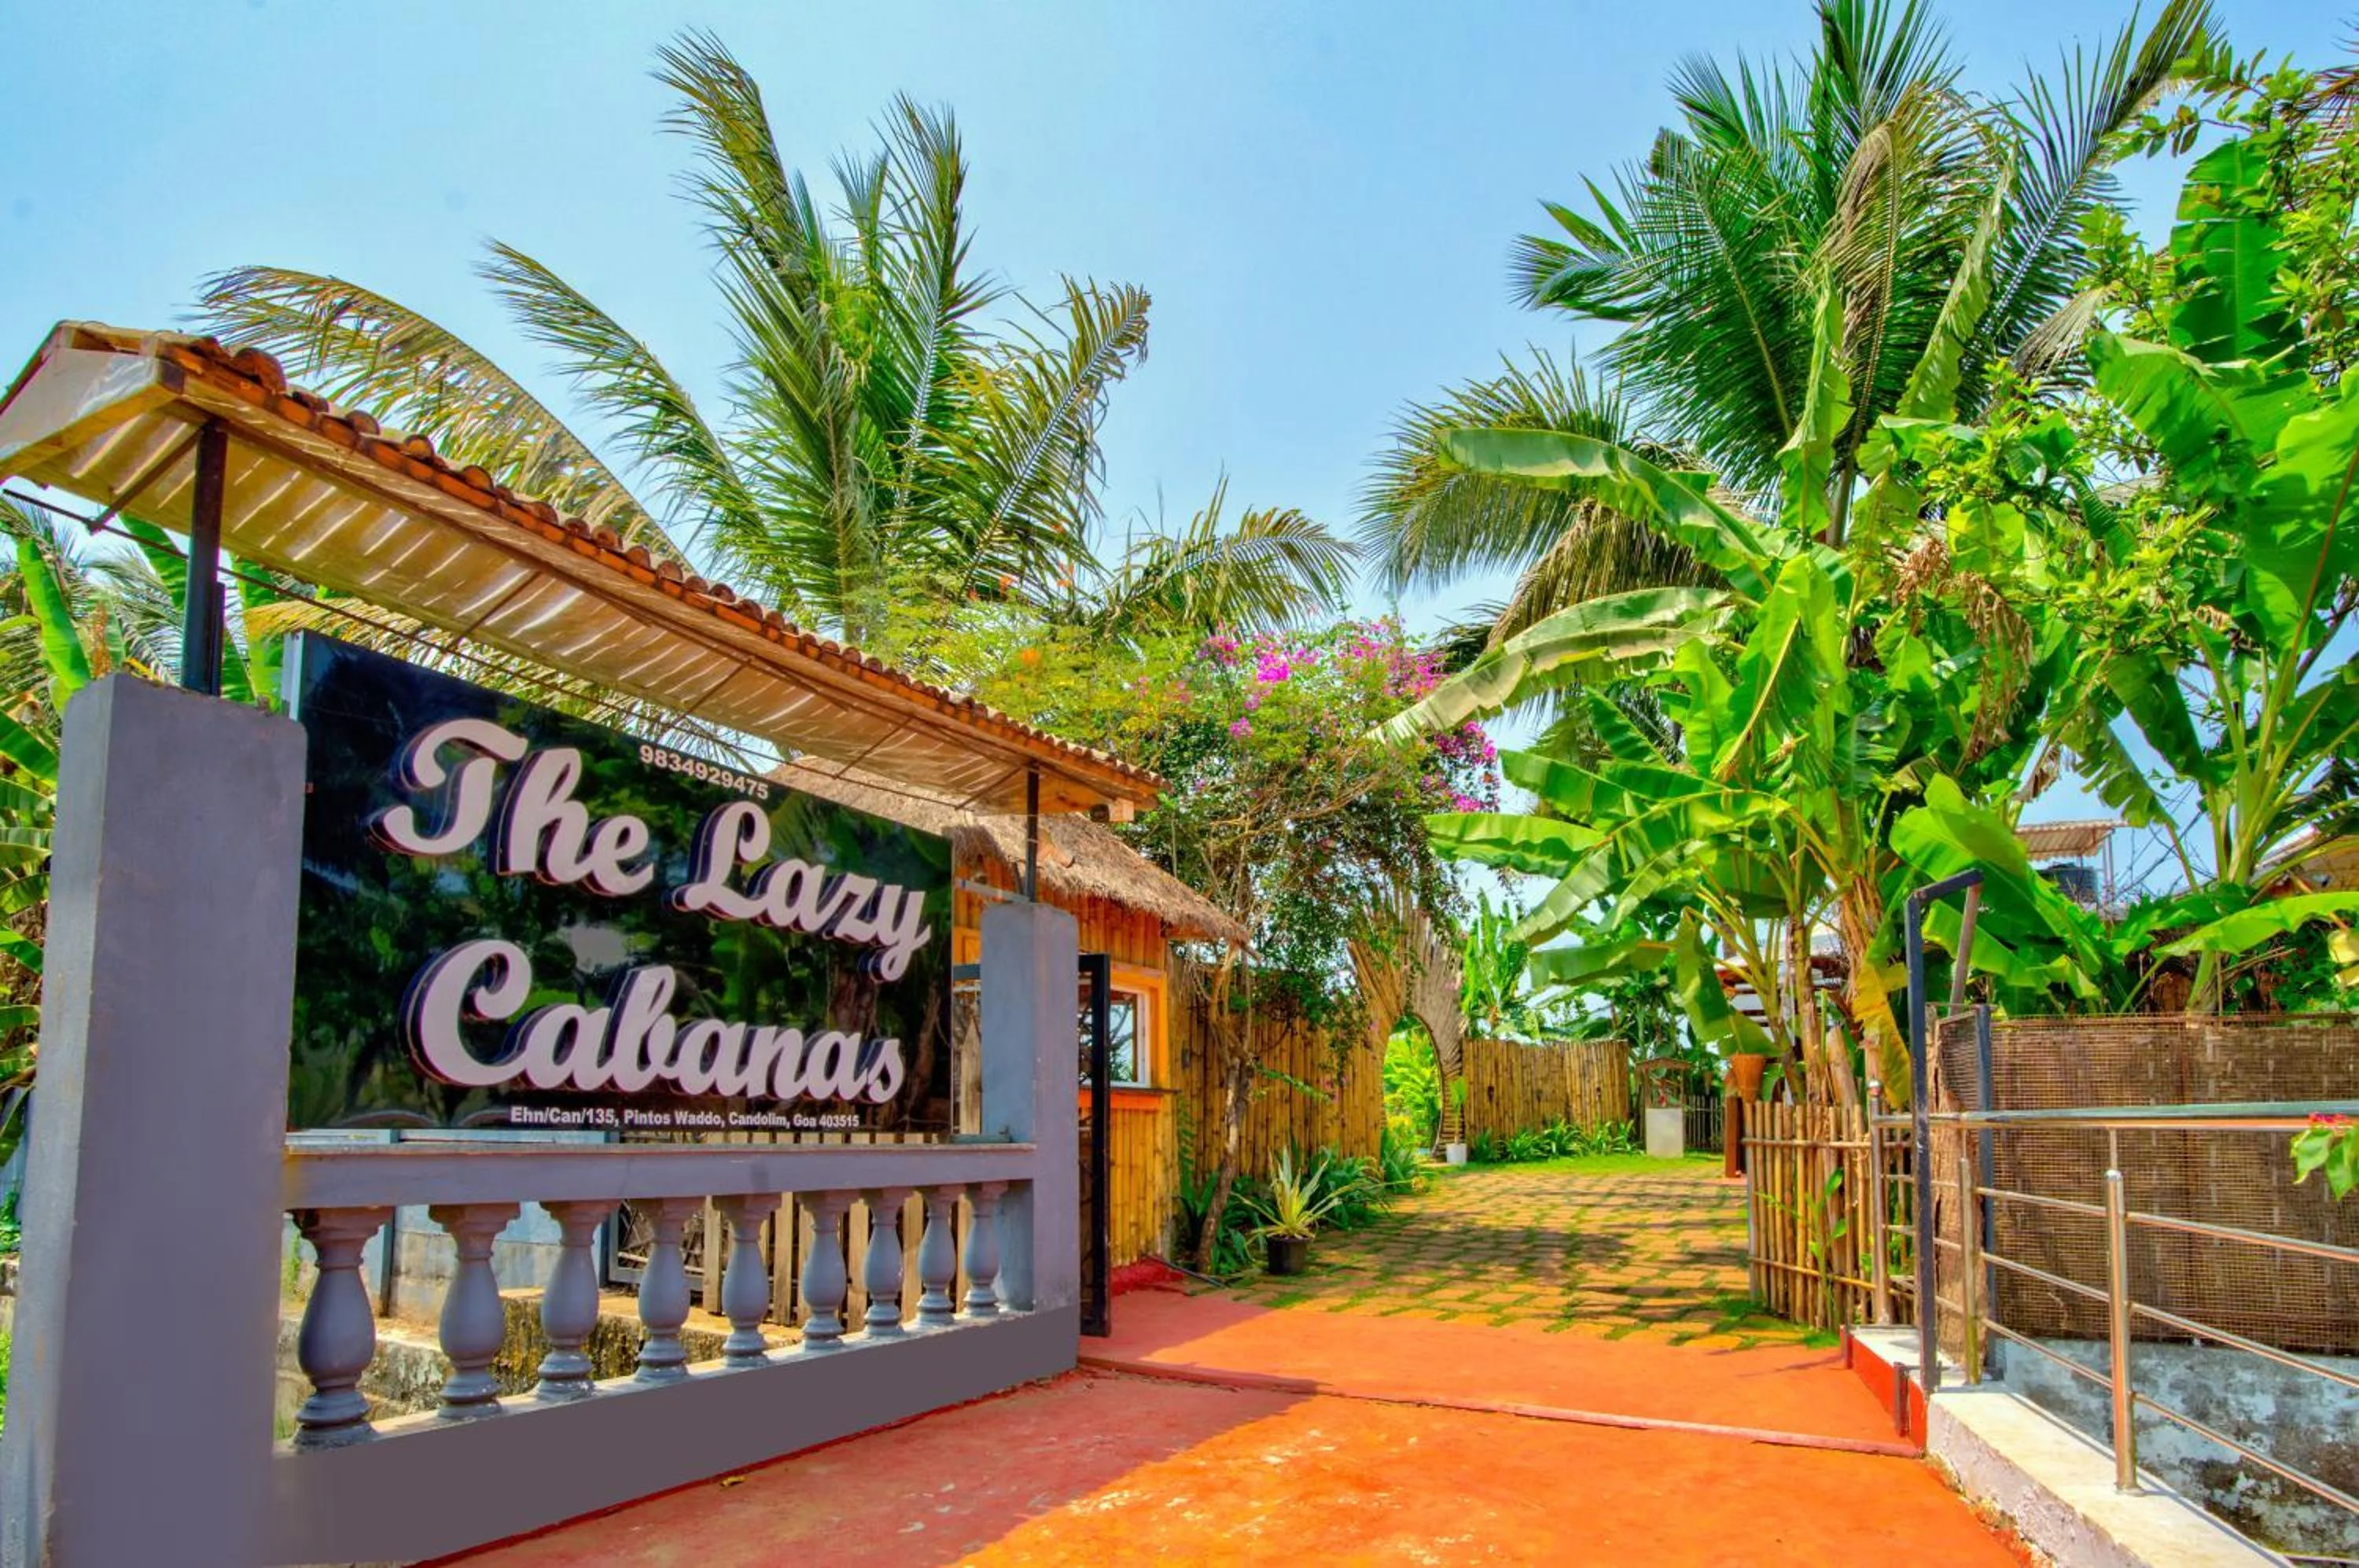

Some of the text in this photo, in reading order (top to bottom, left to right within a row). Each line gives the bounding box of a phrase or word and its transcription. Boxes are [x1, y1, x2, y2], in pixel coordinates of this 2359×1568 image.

[640, 745, 768, 800] 9834929475
[373, 717, 932, 982] The Lazy
[407, 939, 906, 1103] Cabanas
[511, 1106, 859, 1128] Ehn/Can/135, Pintos Waddo, Candolim, Goa 403515
